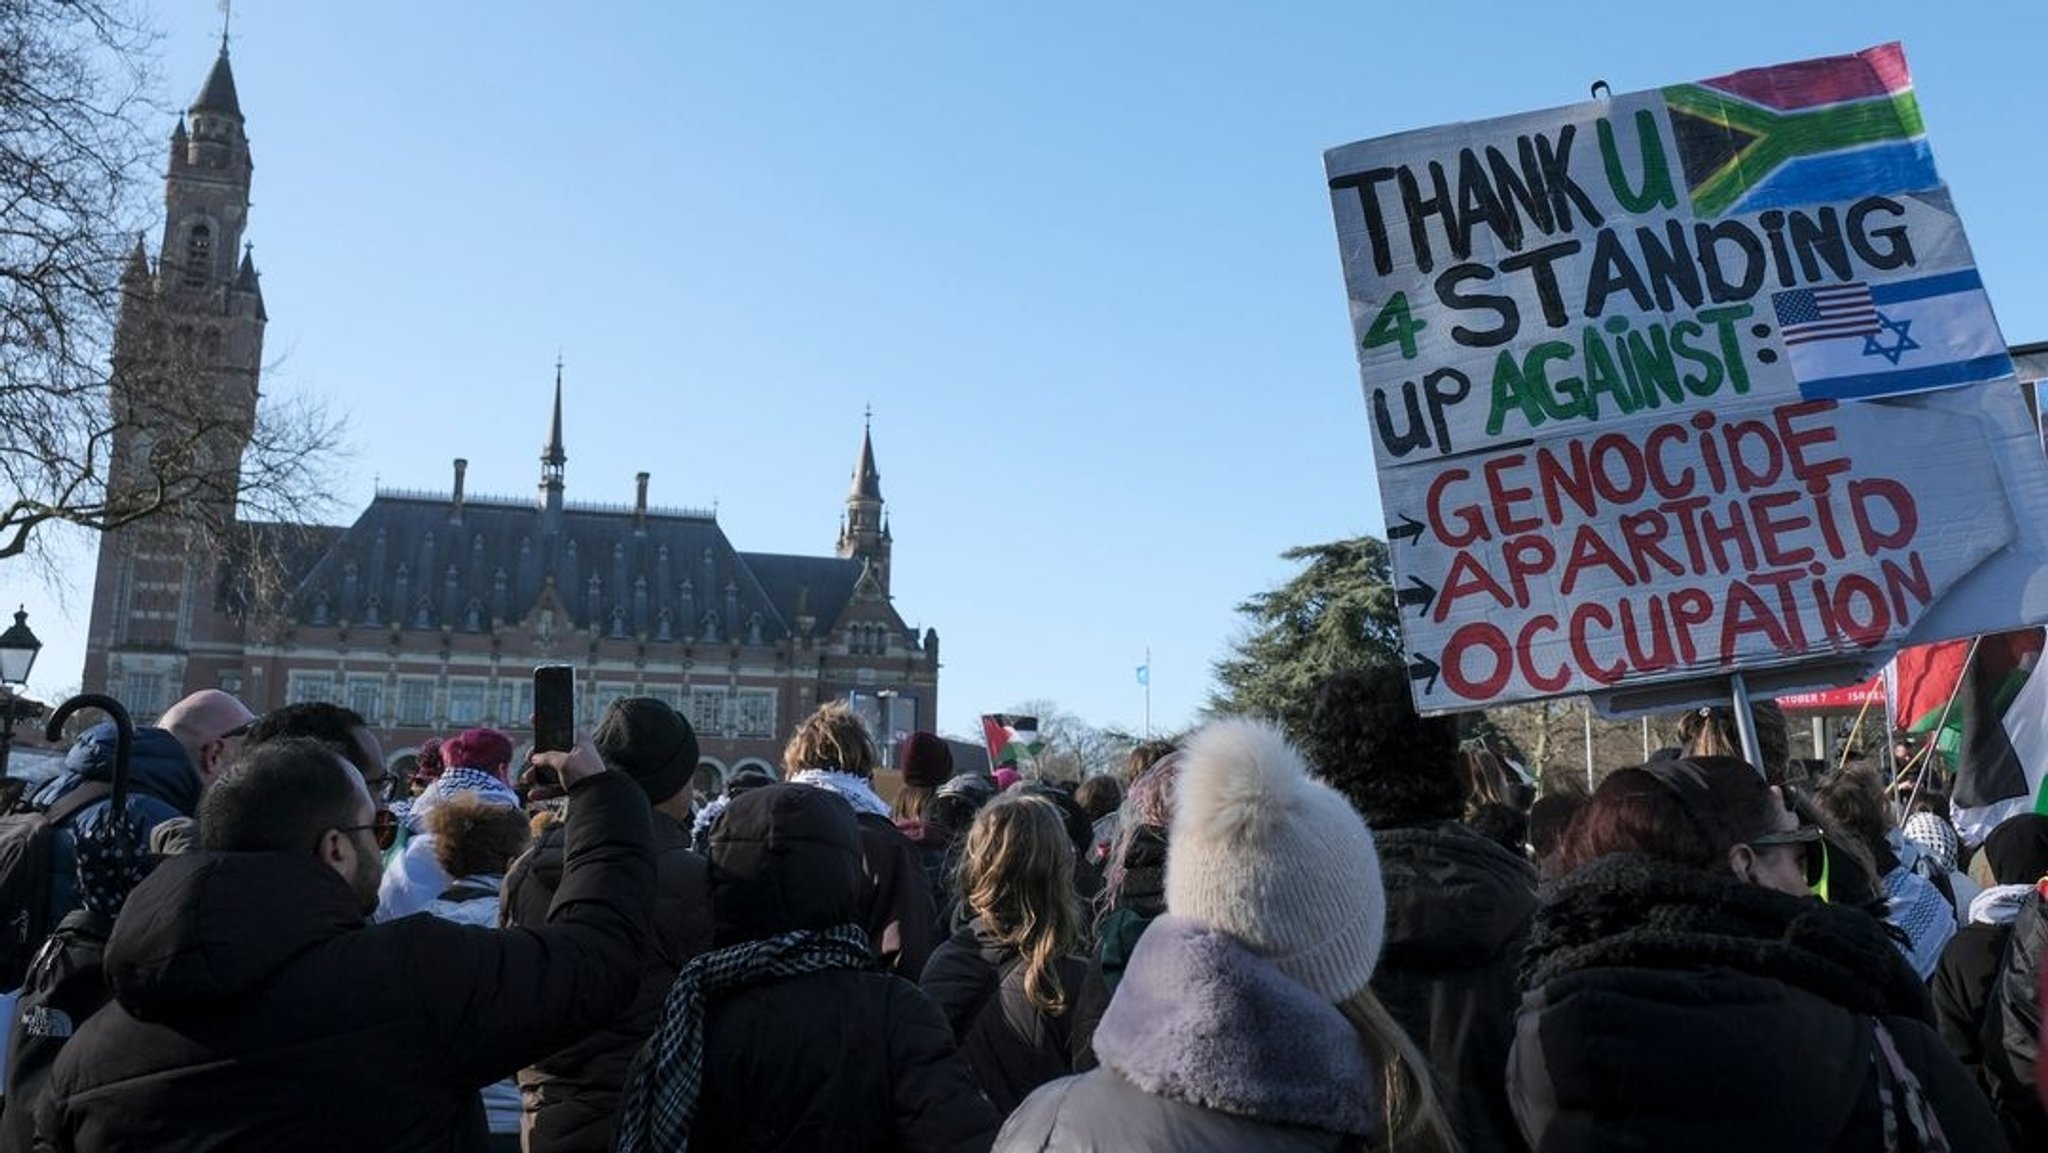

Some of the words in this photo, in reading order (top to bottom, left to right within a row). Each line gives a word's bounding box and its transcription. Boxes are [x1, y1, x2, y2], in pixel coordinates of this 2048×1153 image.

[1329, 124, 1605, 276] THANK
[1596, 109, 1679, 214] U
[1361, 290, 1427, 359] 4
[1374, 367, 1470, 458] UP
